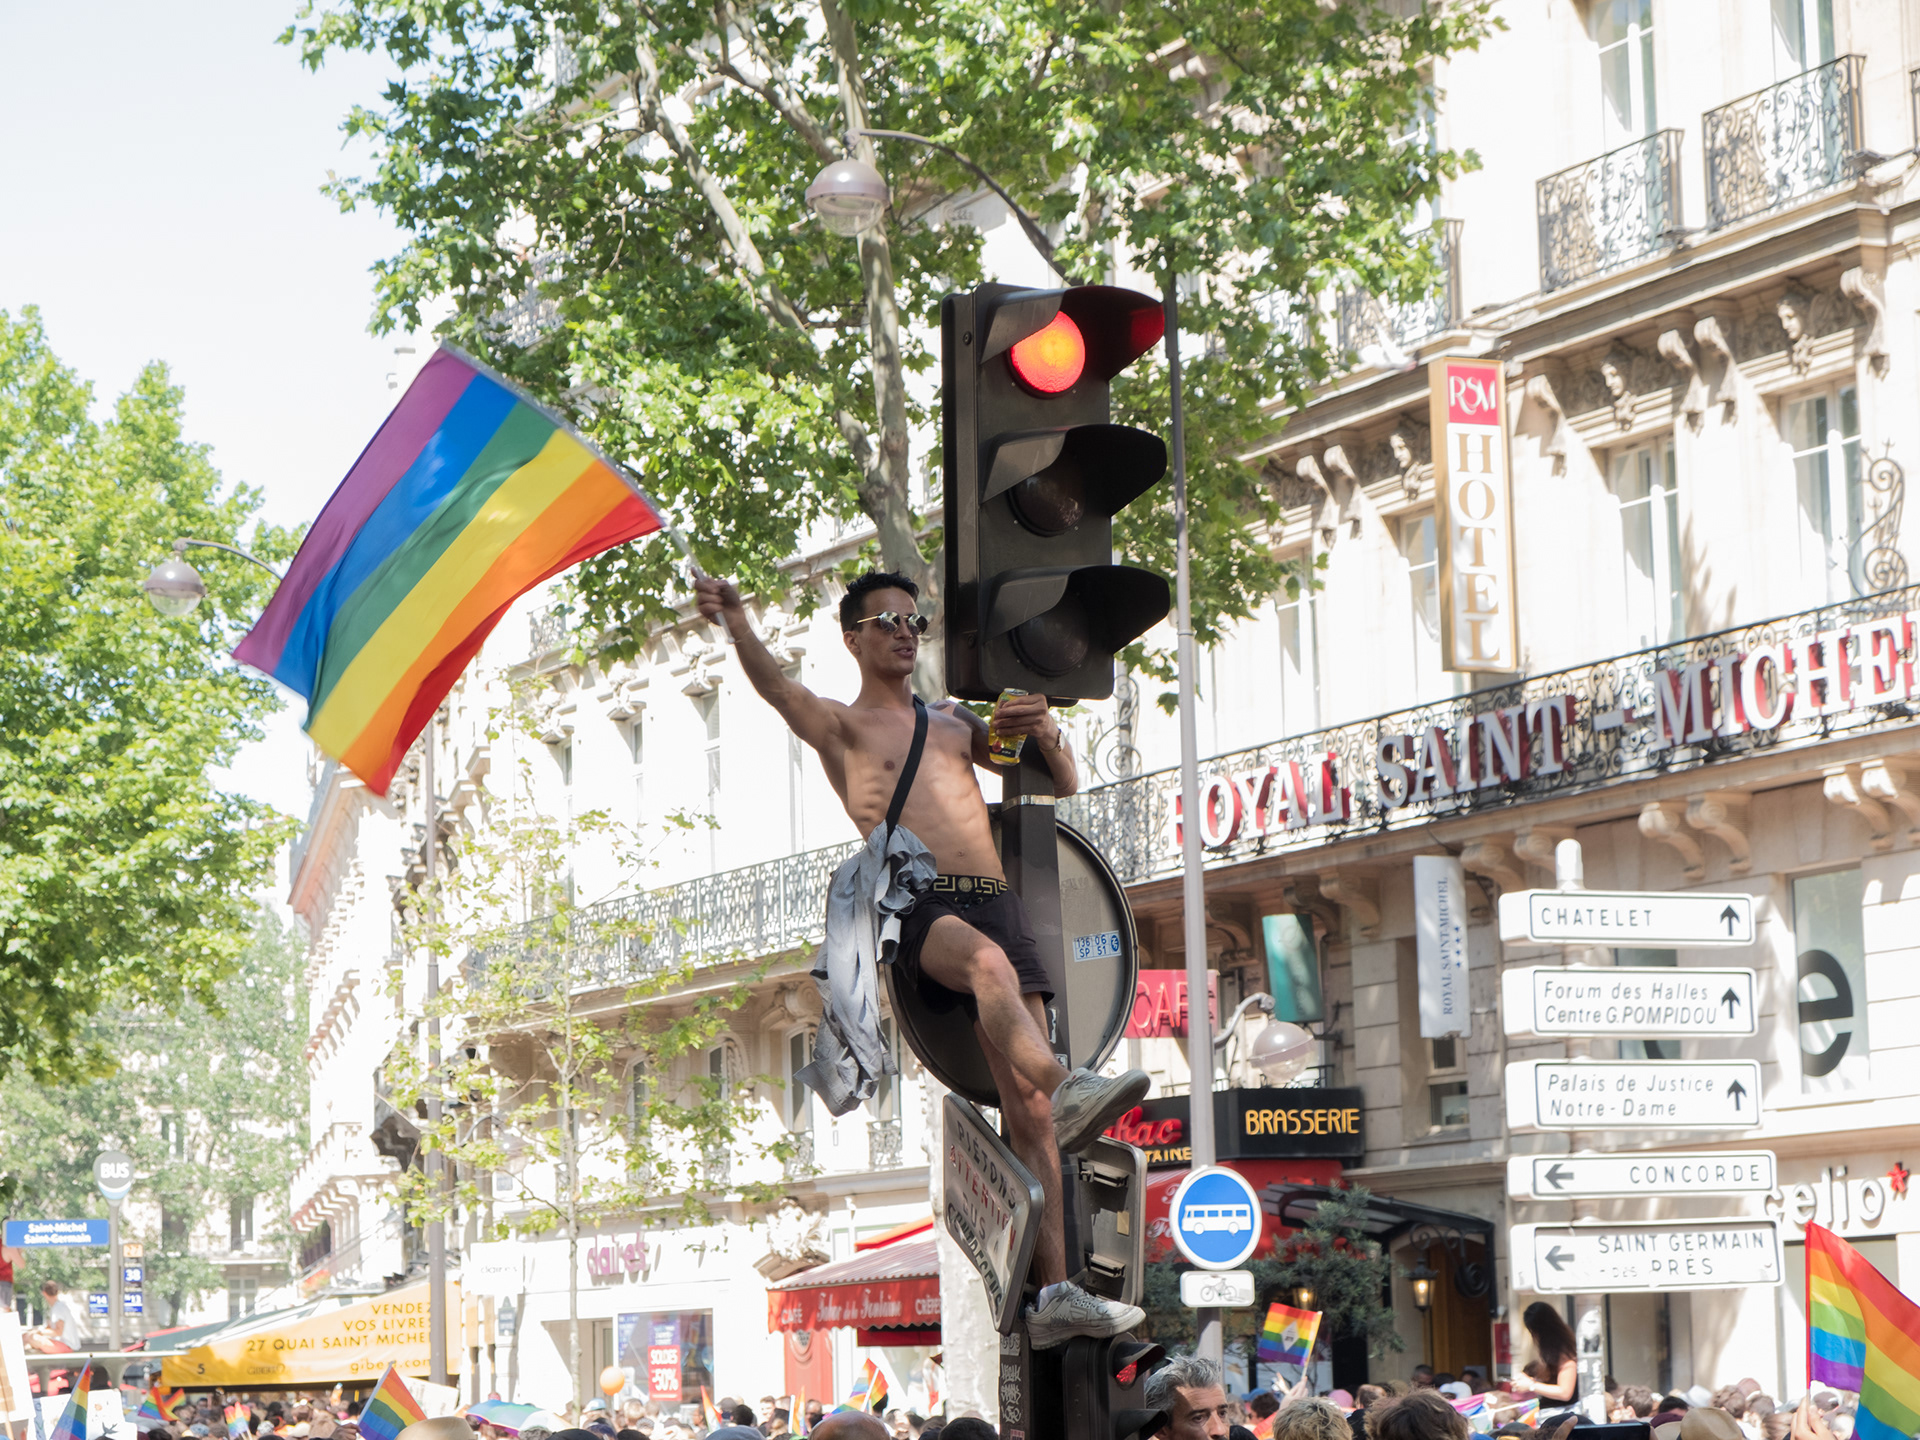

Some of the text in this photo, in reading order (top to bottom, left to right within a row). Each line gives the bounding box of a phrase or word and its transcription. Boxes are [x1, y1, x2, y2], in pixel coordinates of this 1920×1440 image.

[1449, 376, 1496, 415] RSM
[1457, 432, 1500, 662] HOTEL
[1377, 695, 1572, 808] SAINT
[1541, 907, 1653, 927] CHATELET
[1095, 934, 1107, 946] 06
[1079, 948, 1091, 958] SP
[1441, 974, 1453, 1015] ROYAL
[1544, 980, 1708, 1000] Forum des Halles
[1132, 981, 1190, 1029] CAF
[1545, 1005, 1602, 1023] Centre
[1548, 1074, 1714, 1092] Palais de Justice
[1103, 1106, 1182, 1147] bac
[1245, 1108, 1361, 1136] BRASSERIE
[1145, 1147, 1192, 1163] TAINE
[101, 1162, 129, 1178] BUS
[1630, 1164, 1760, 1184] CONCORDE
[28, 1222, 87, 1234] Saint-Michel
[24, 1233, 92, 1245] Saint-Germain
[1598, 1232, 1765, 1254] SAINT GERMAIN
[125, 1269, 141, 1281] 38
[343, 1316, 430, 1332] VOS LIVRE
[781, 1303, 803, 1325] CAFÉ
[247, 1332, 430, 1352] 27 QUAI SAINT MICHE
[651, 1349, 678, 1365] SOLDES
[197, 1363, 206, 1375] 5
